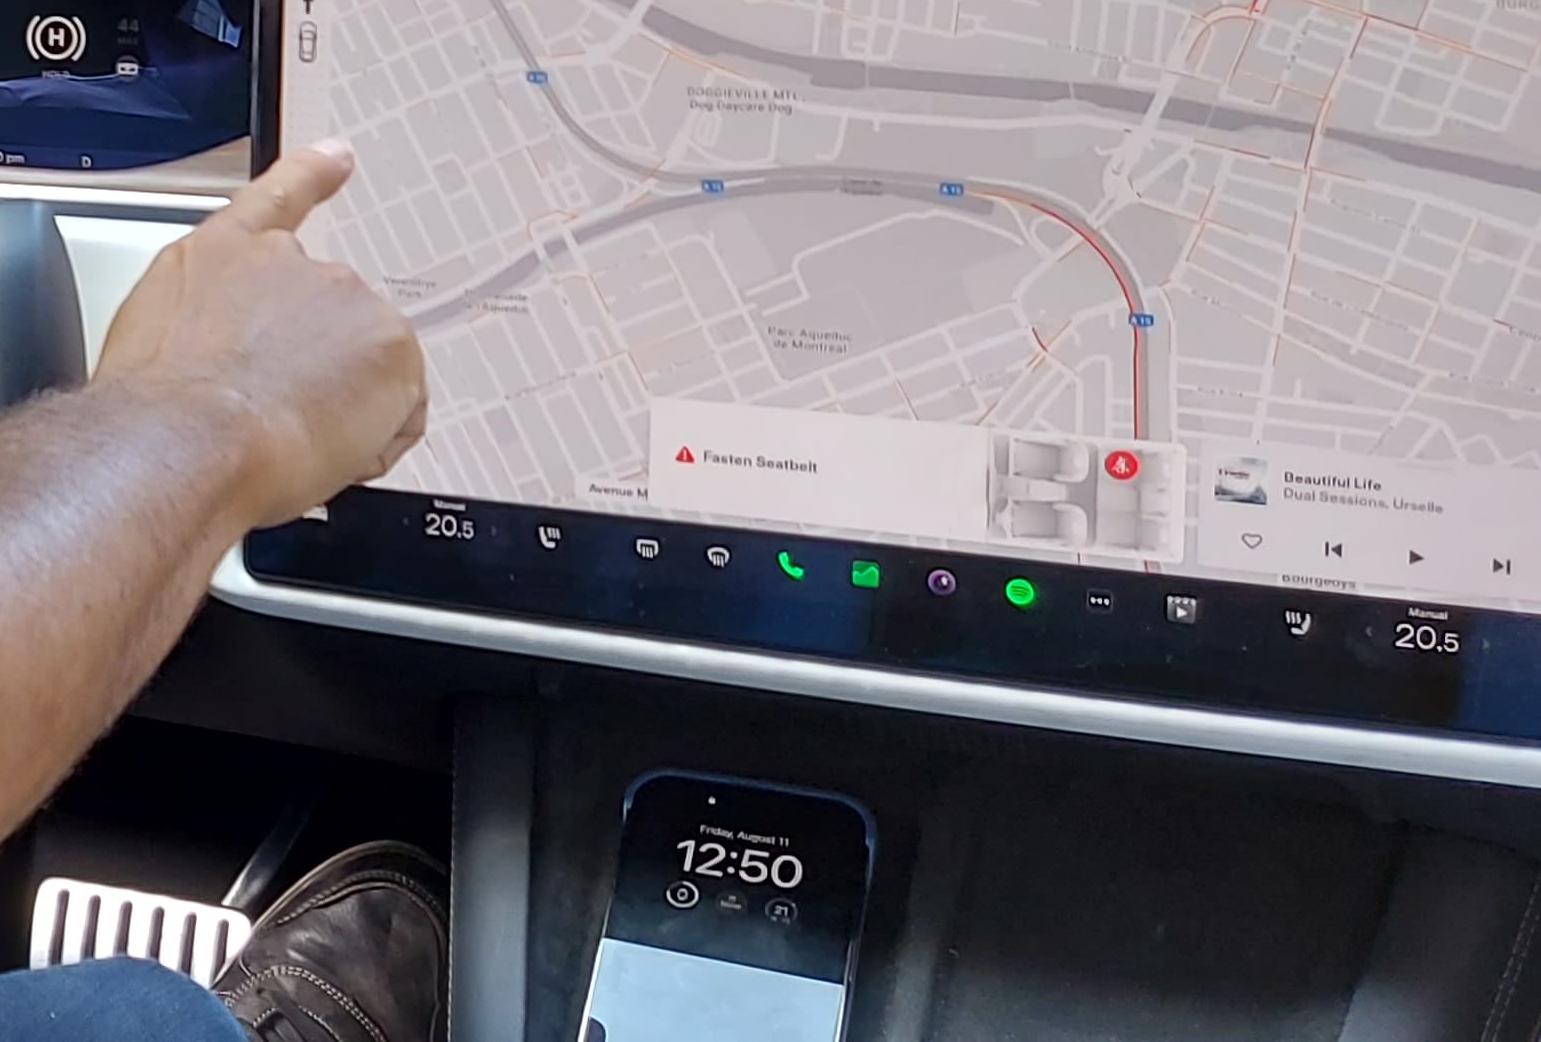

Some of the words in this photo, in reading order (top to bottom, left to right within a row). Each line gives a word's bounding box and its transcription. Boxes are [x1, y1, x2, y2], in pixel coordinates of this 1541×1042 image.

[703, 451, 753, 468] Fasten
[756, 456, 818, 474] Seatbelt
[589, 483, 634, 498] Avenue
[1284, 471, 1351, 490] Beautiful
[1354, 477, 1382, 491] Life
[1283, 488, 1316, 503] Dual
[424, 513, 474, 539] 20.5
[737, 831, 776, 846] August
[779, 837, 790, 847] 11
[677, 839, 803, 888] 12:50
